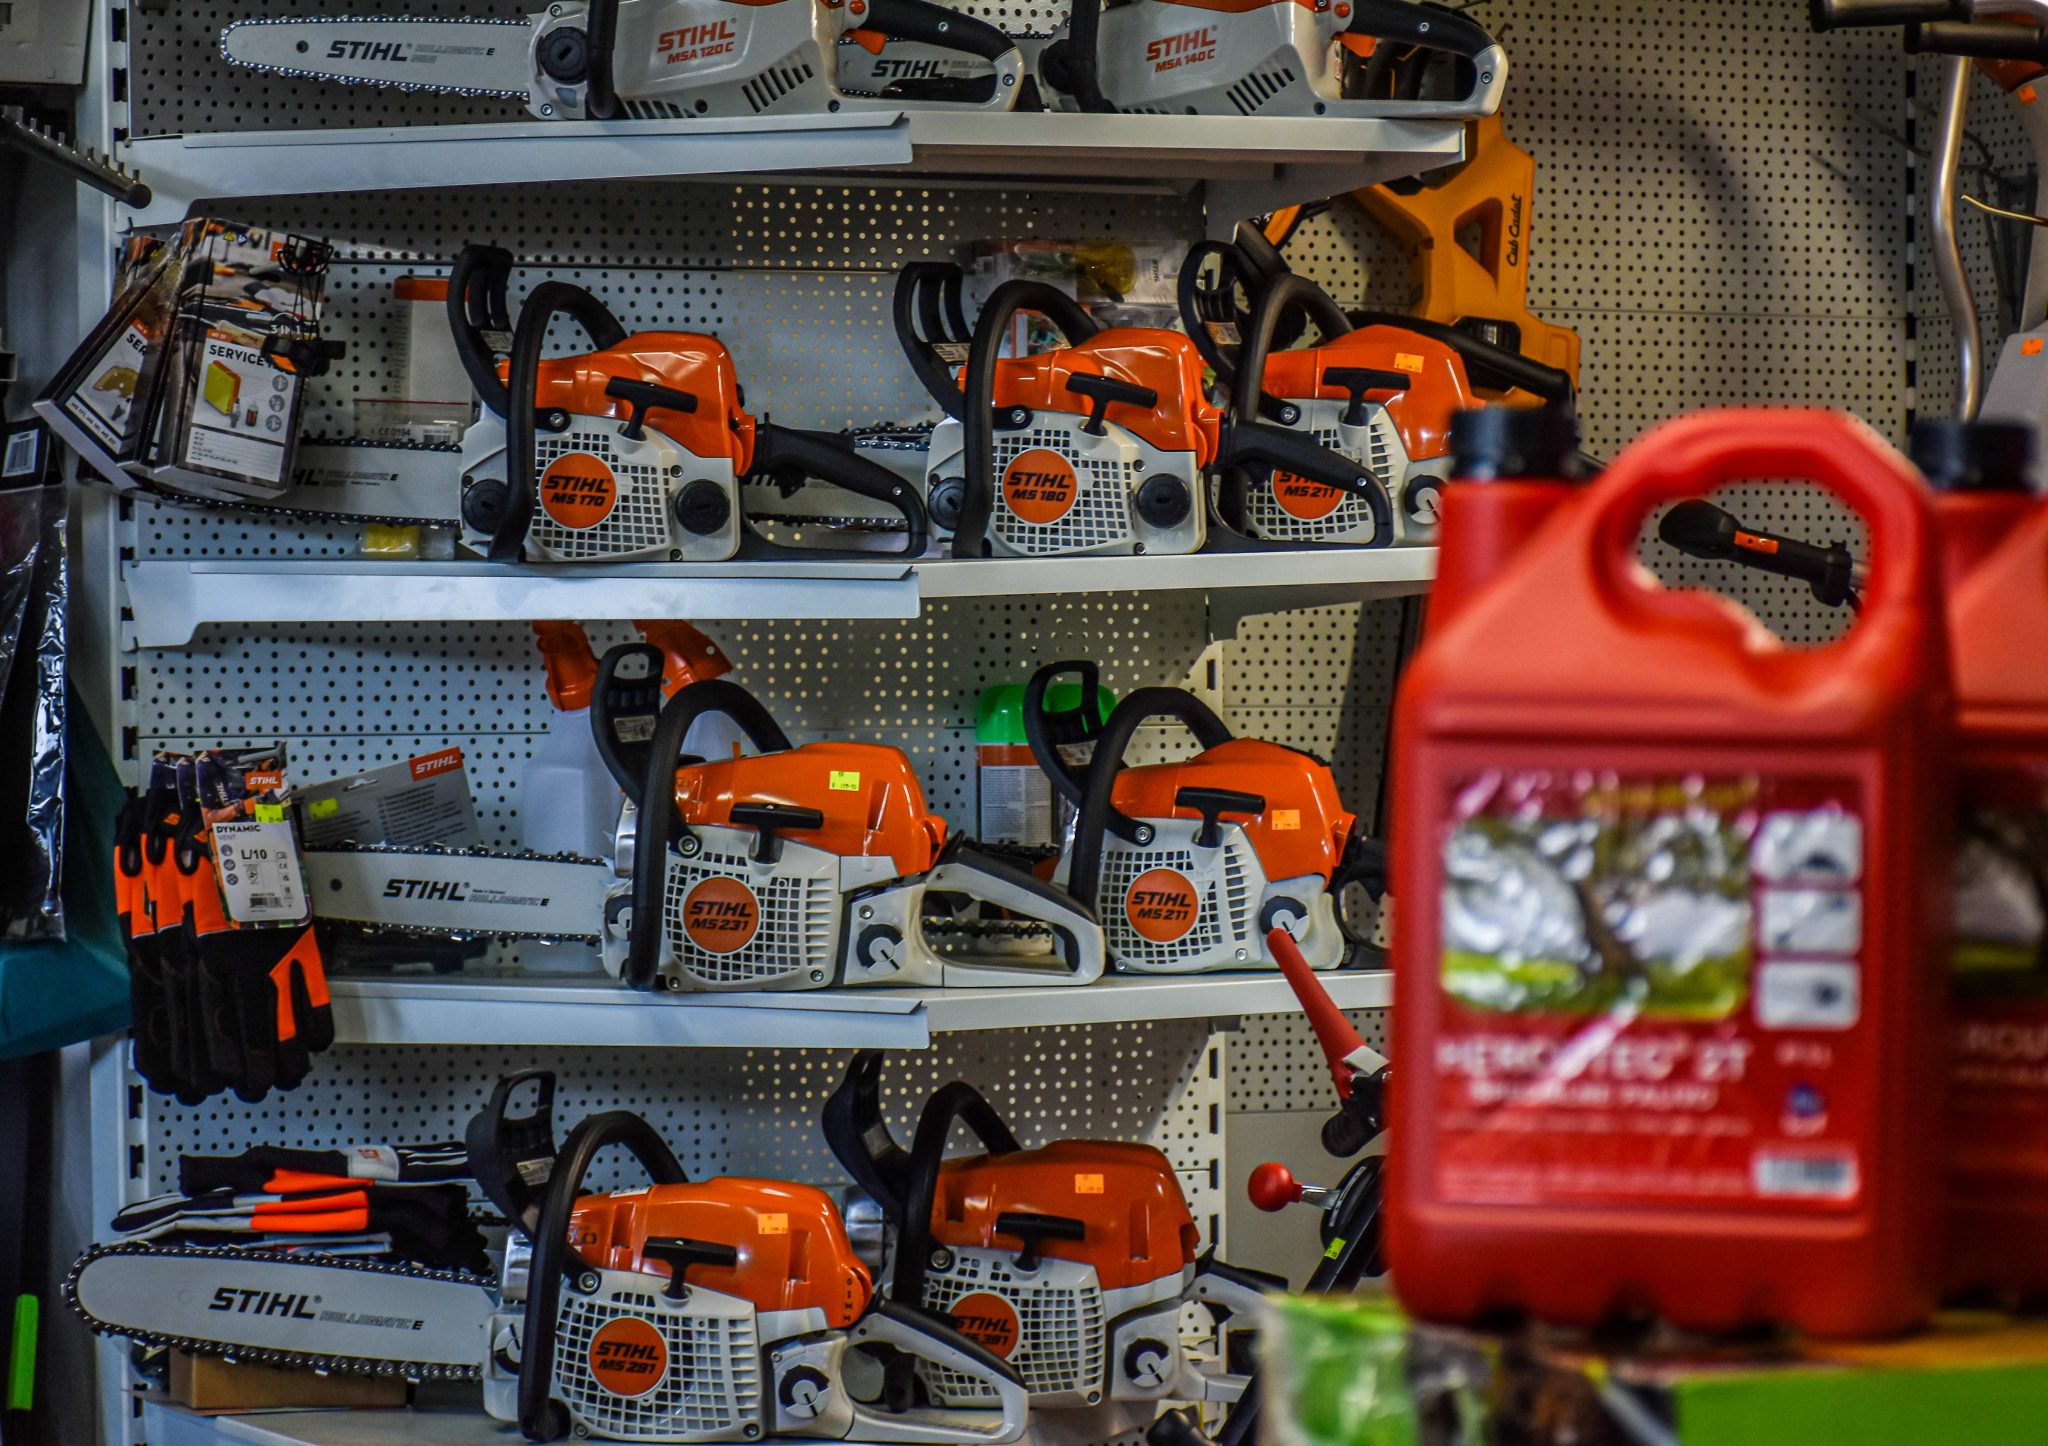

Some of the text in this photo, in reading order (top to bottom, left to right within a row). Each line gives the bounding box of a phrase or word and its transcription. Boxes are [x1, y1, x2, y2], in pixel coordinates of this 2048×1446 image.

[657, 20, 735, 52] STIHL
[1146, 28, 1216, 61] STIHL
[326, 40, 408, 62] STIHL
[667, 48, 698, 64] MSA
[871, 59, 945, 79] STIHL
[1155, 56, 1182, 72] MSA
[1506, 193, 1522, 267] Cub Cadet
[209, 344, 265, 367] SERVICE
[544, 475, 609, 493] STIHL
[1007, 472, 1071, 489] STIHL
[551, 493, 606, 506] MS 170
[1012, 489, 1067, 502] MS 180
[415, 755, 458, 774] STIHL
[249, 776, 279, 784] STIHL
[216, 824, 261, 833] DYNAMIC
[241, 849, 268, 860] L/10
[383, 879, 466, 902] STIHL
[1131, 891, 1192, 907] STIHL
[689, 901, 752, 918] STIHL
[208, 1287, 316, 1320] STIHL
[411, 1320, 424, 1331] E
[595, 1341, 660, 1360] STIHL
[598, 1358, 657, 1375] MS 291
